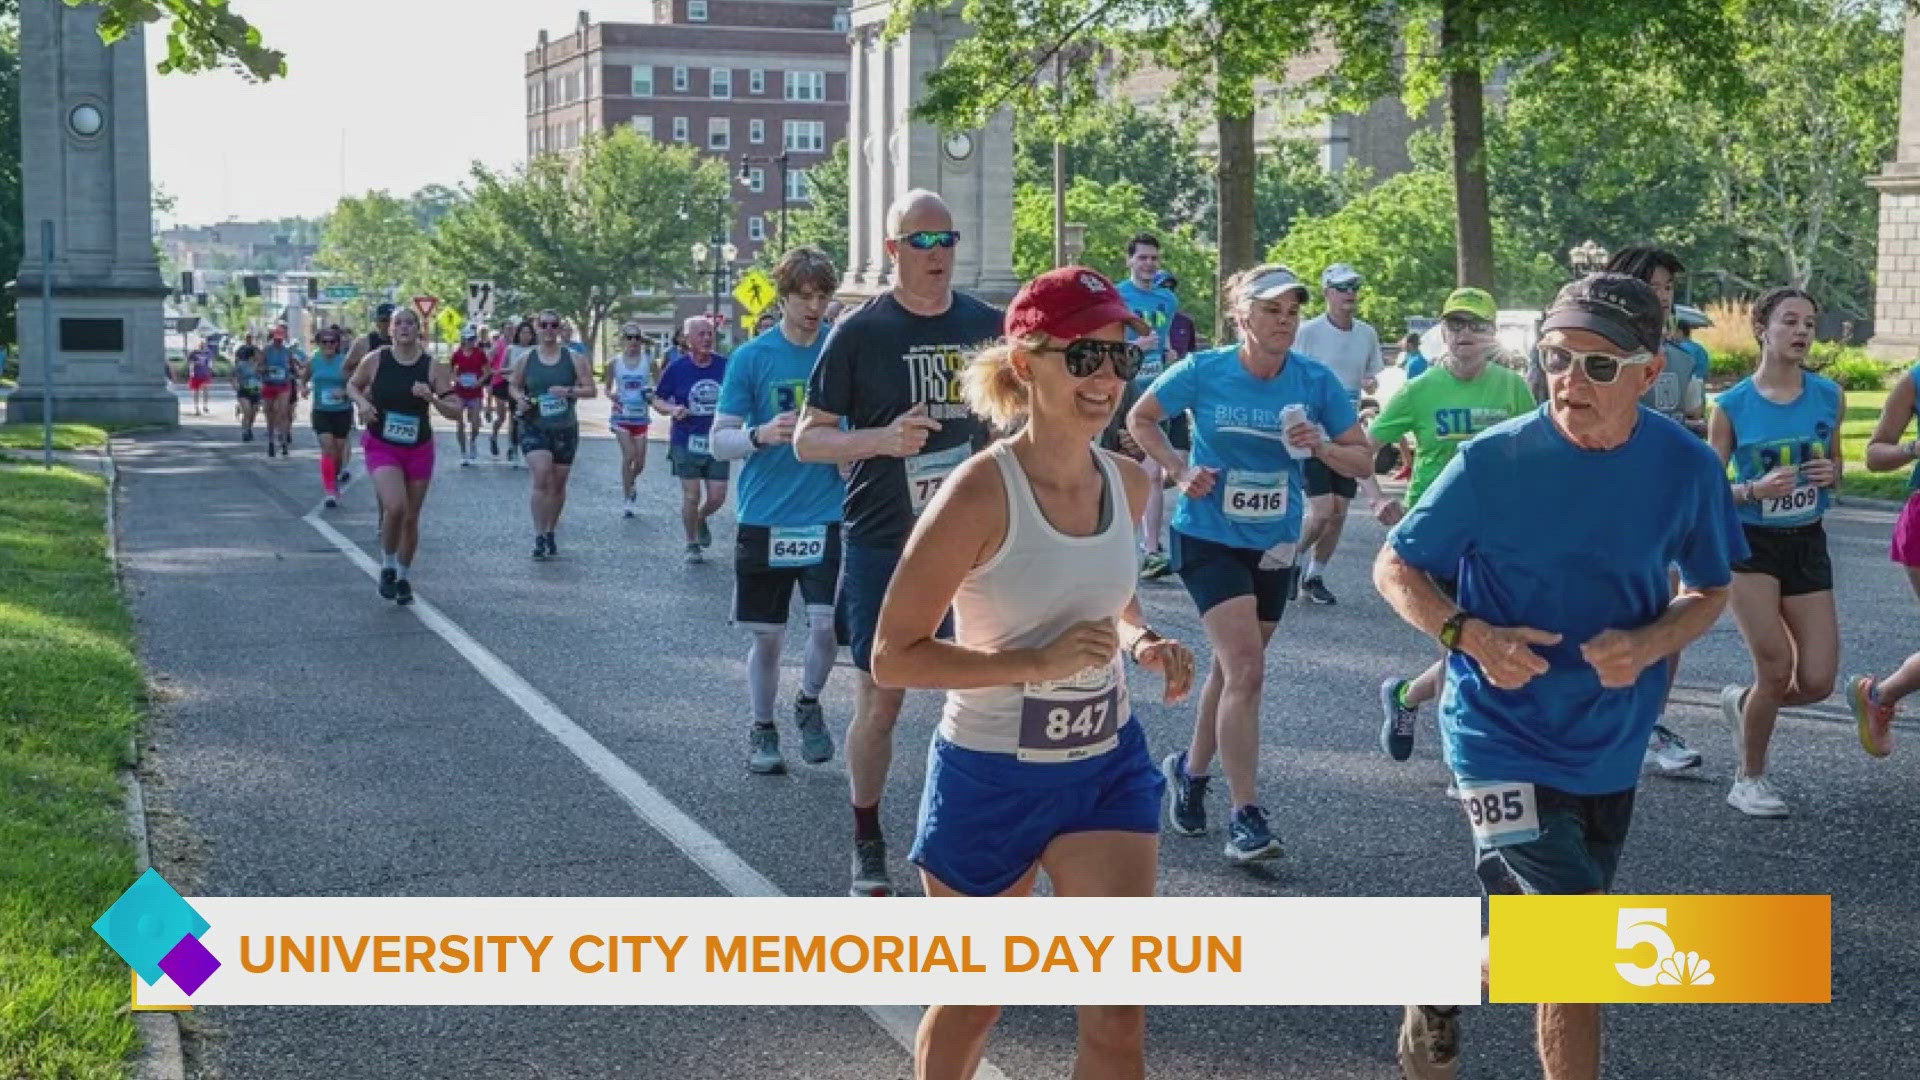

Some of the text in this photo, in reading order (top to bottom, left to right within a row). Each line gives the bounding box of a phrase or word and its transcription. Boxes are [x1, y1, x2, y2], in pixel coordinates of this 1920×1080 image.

[1215, 404, 1247, 424] BIG
[1232, 492, 1280, 510] 6416
[1770, 488, 1816, 512] 7809
[774, 540, 821, 557] 6420
[1046, 700, 1108, 740] 847
[1463, 789, 1523, 826] 985
